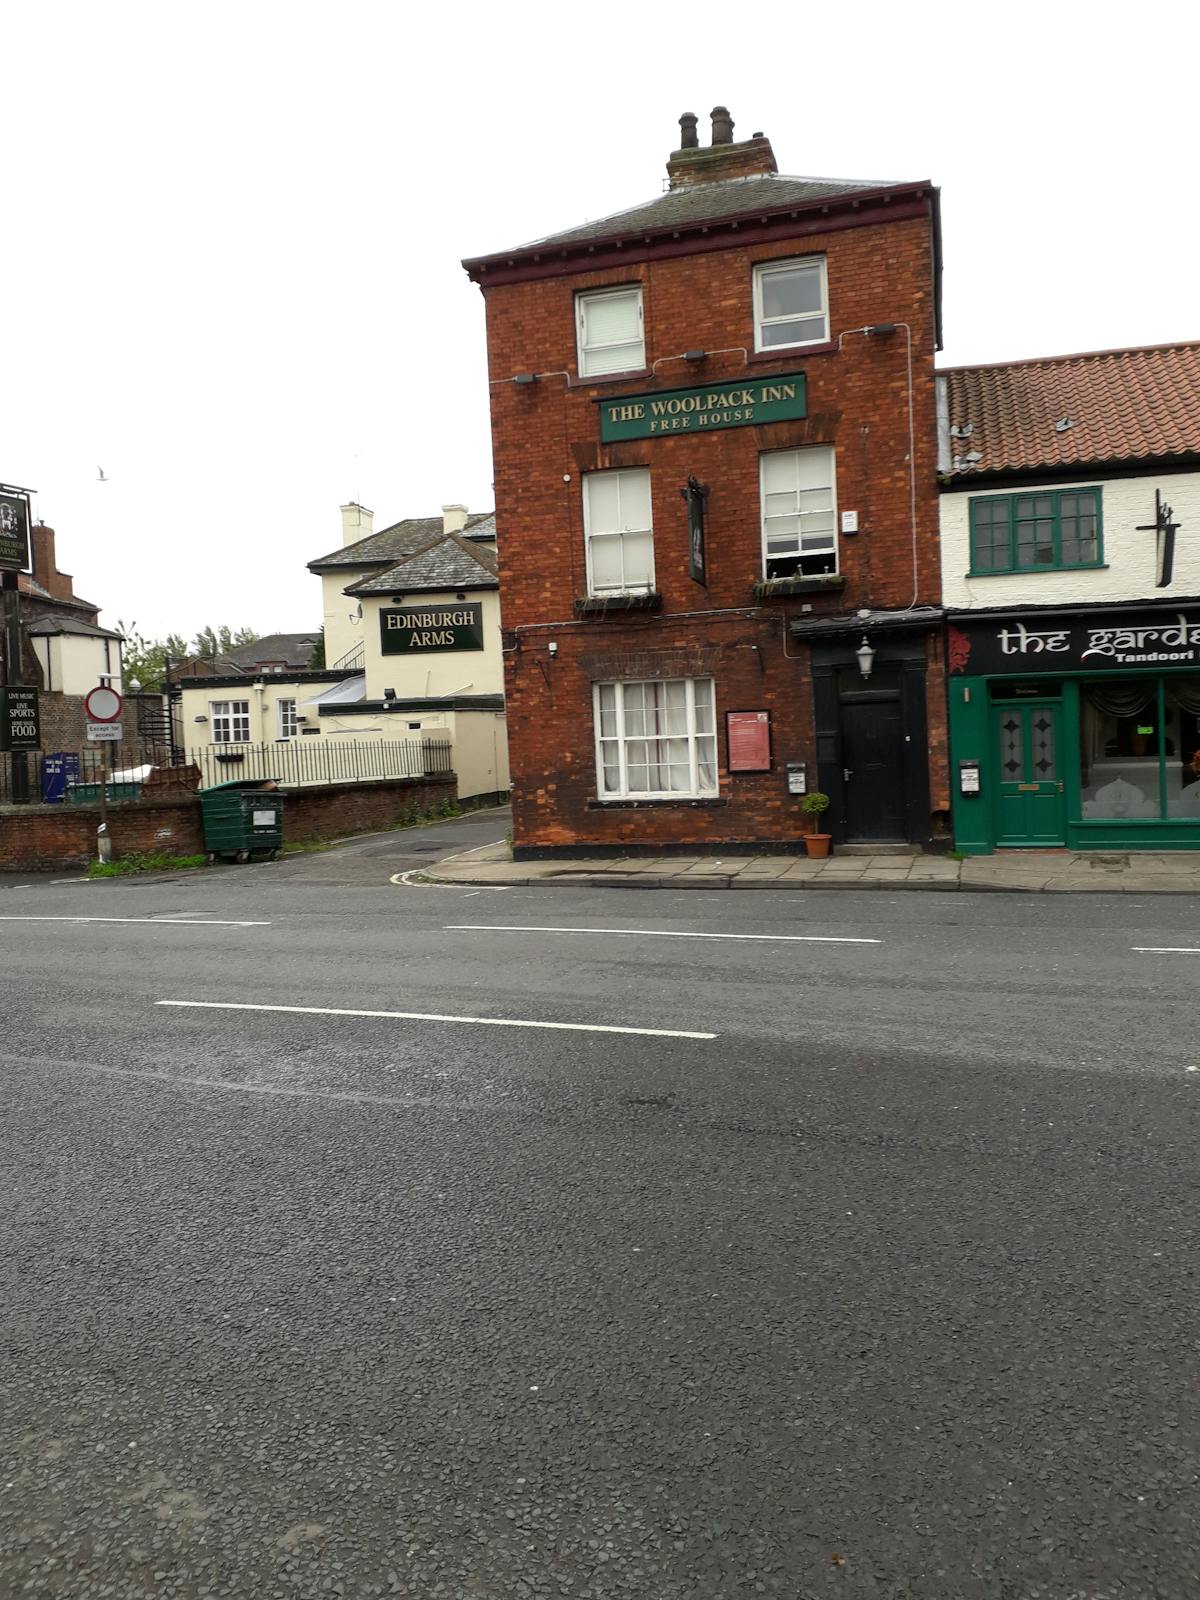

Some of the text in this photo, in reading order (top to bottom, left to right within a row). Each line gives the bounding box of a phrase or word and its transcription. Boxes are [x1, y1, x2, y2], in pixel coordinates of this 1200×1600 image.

[608, 383, 796, 422] THE WOOLPACK INN
[649, 408, 754, 432] FREE HOUSE
[386, 611, 475, 630] EDINBURGH
[409, 630, 455, 647] ARMS
[997, 623, 1071, 655] the
[1114, 650, 1194, 663] Tandoori
[9, 709, 35, 718] SPORTS
[11, 725, 36, 737] FOOD
